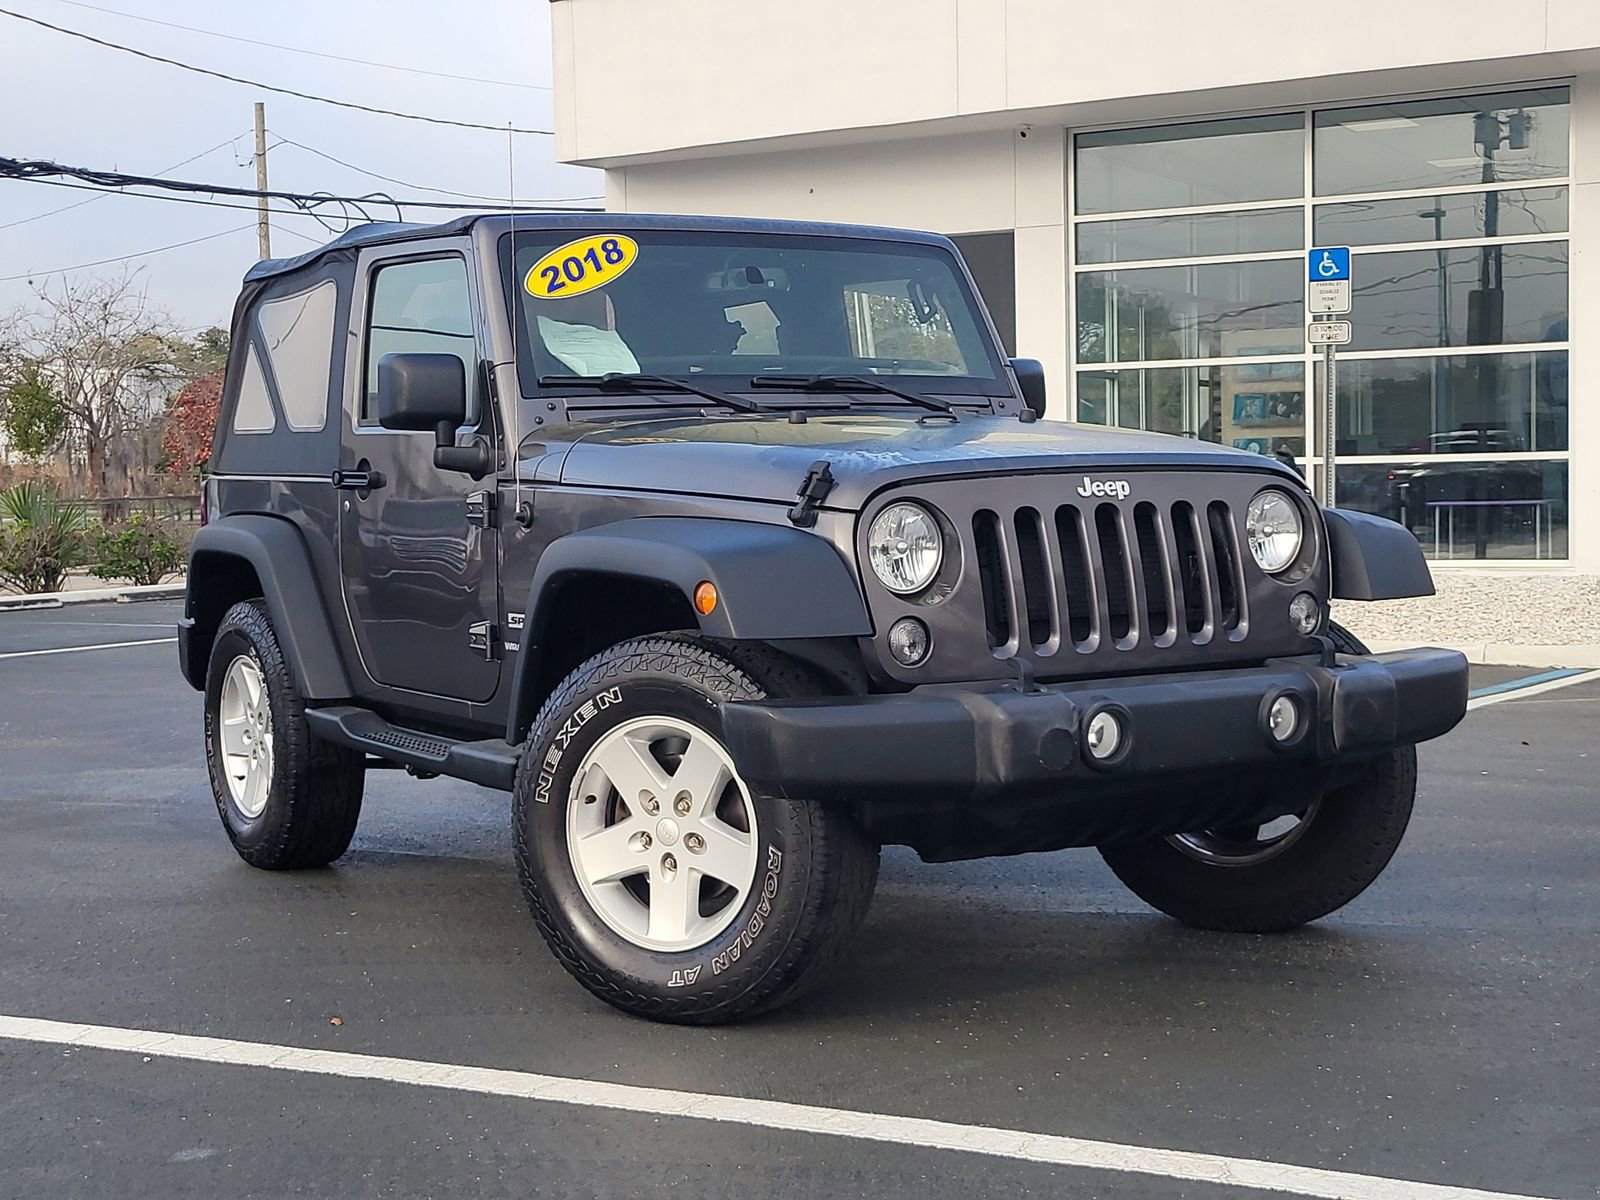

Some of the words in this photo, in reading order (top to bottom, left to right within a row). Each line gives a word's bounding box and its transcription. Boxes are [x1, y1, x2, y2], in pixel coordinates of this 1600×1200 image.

[540, 238, 625, 294] 2018
[1077, 476, 1131, 500] Jeep
[535, 686, 622, 803] NEXEN
[711, 844, 783, 975] ROADIAN
[667, 964, 703, 987] AT
